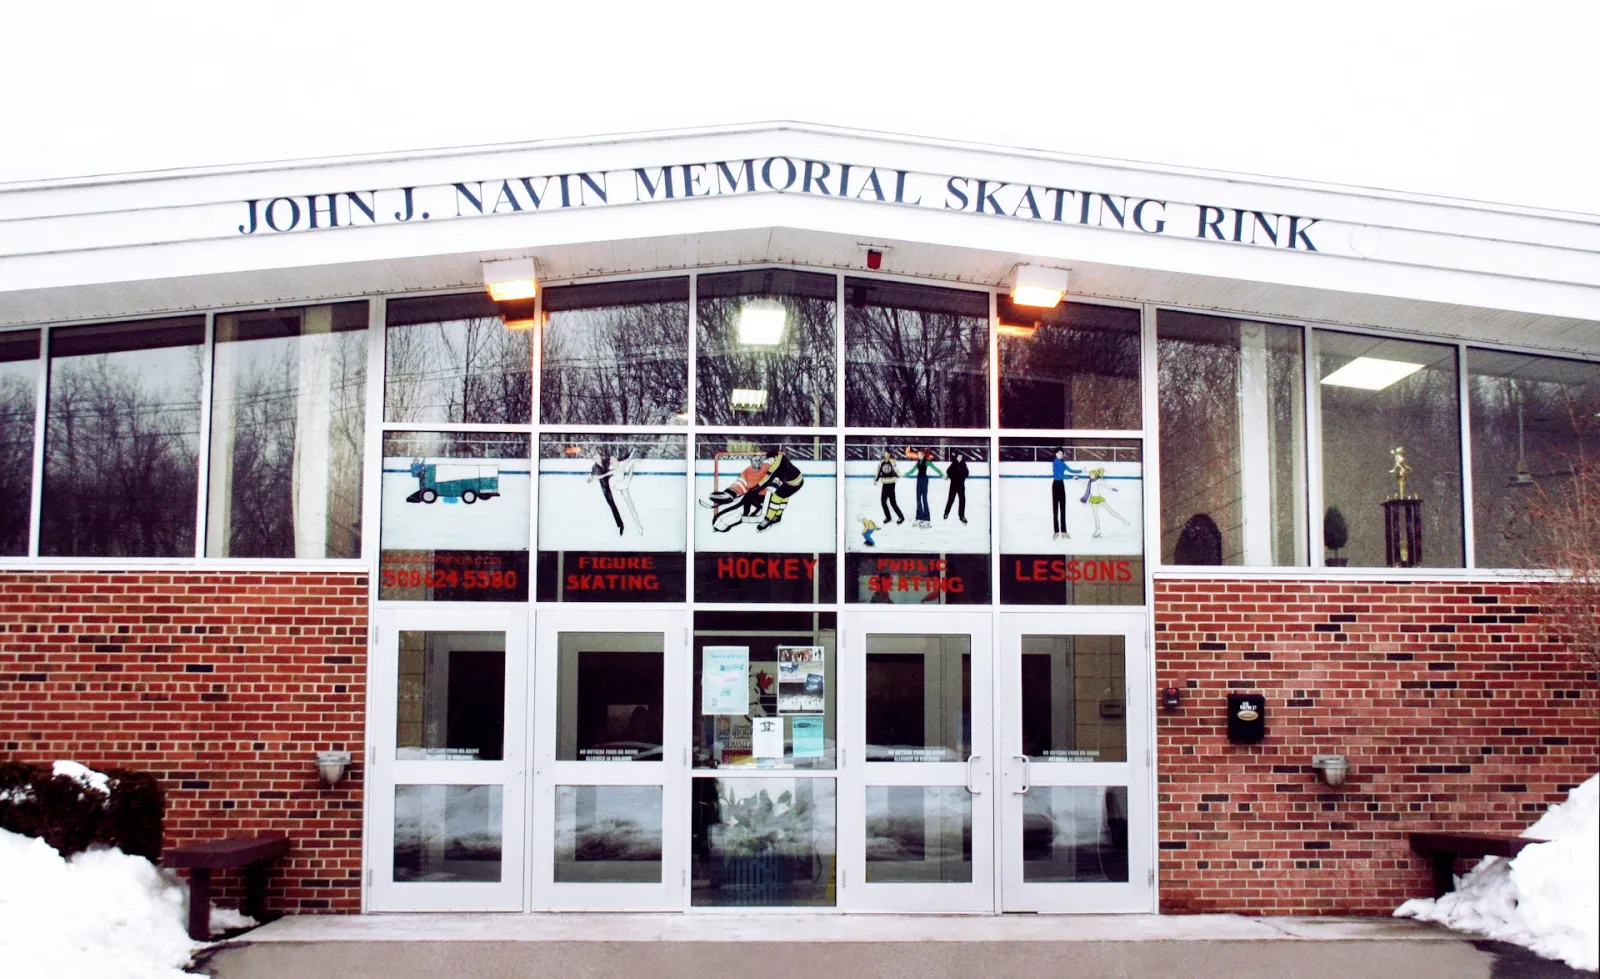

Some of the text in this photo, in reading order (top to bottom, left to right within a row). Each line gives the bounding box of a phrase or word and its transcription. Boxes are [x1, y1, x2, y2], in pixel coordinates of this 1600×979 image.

[238, 156, 1322, 251] JOHN J. NAVIN MEMORIAL SKATING RINK
[579, 557, 653, 570] FIGURE
[718, 558, 818, 580] HOCKEY
[876, 558, 948, 572] PUBLIC
[1015, 560, 1132, 582] LESSONS
[566, 575, 658, 591] SKATING
[868, 576, 964, 593] SKATING
